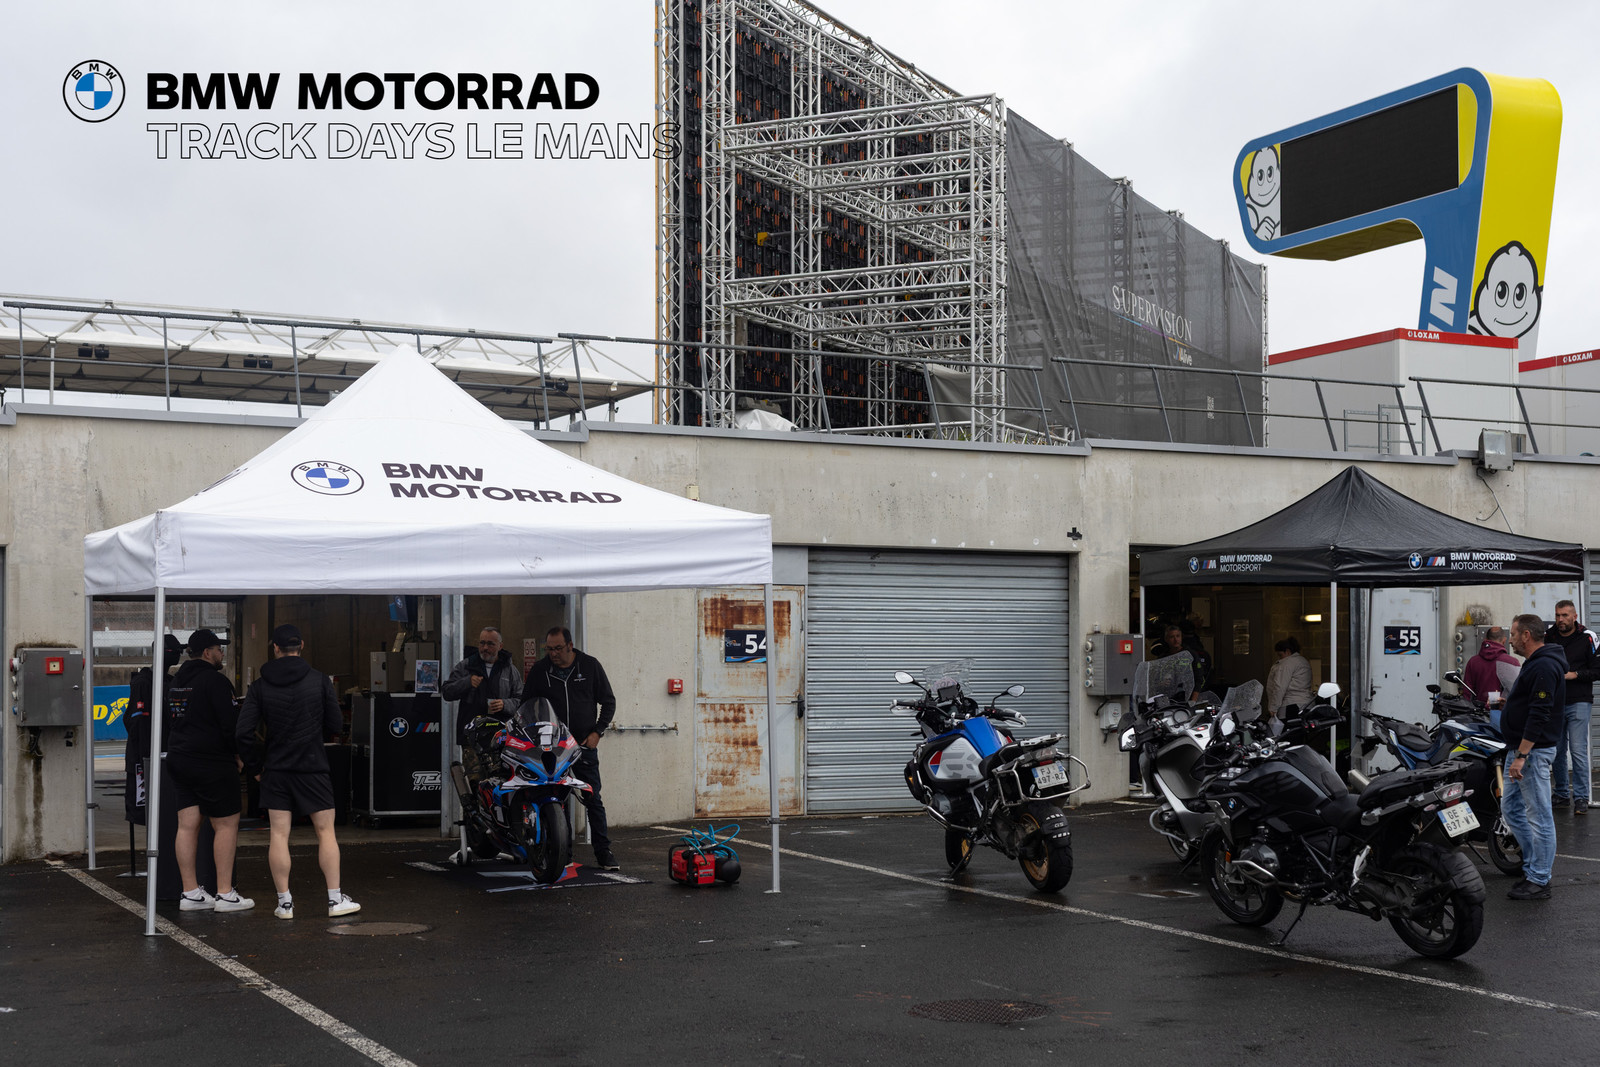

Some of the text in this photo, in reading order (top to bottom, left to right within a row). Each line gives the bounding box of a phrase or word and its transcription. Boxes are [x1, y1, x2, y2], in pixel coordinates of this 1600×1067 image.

[1112, 284, 1193, 343] SUPERVISION
[1413, 331, 1440, 341] LOXAM
[1568, 352, 1593, 362] LOXAM
[299, 462, 350, 473] BMW
[381, 463, 484, 482] BMW
[389, 482, 623, 504] MOTORRAD
[1220, 554, 1273, 563] BMW MOTORRAD
[1450, 552, 1517, 561] BMW MOTORRAD
[1220, 563, 1262, 573] MOTORSPORT
[1450, 561, 1504, 571] MOTORSPORT
[1399, 629, 1420, 647] 55
[1038, 773, 1065, 784] 497-RZ
[1445, 814, 1475, 831] 637-WY
